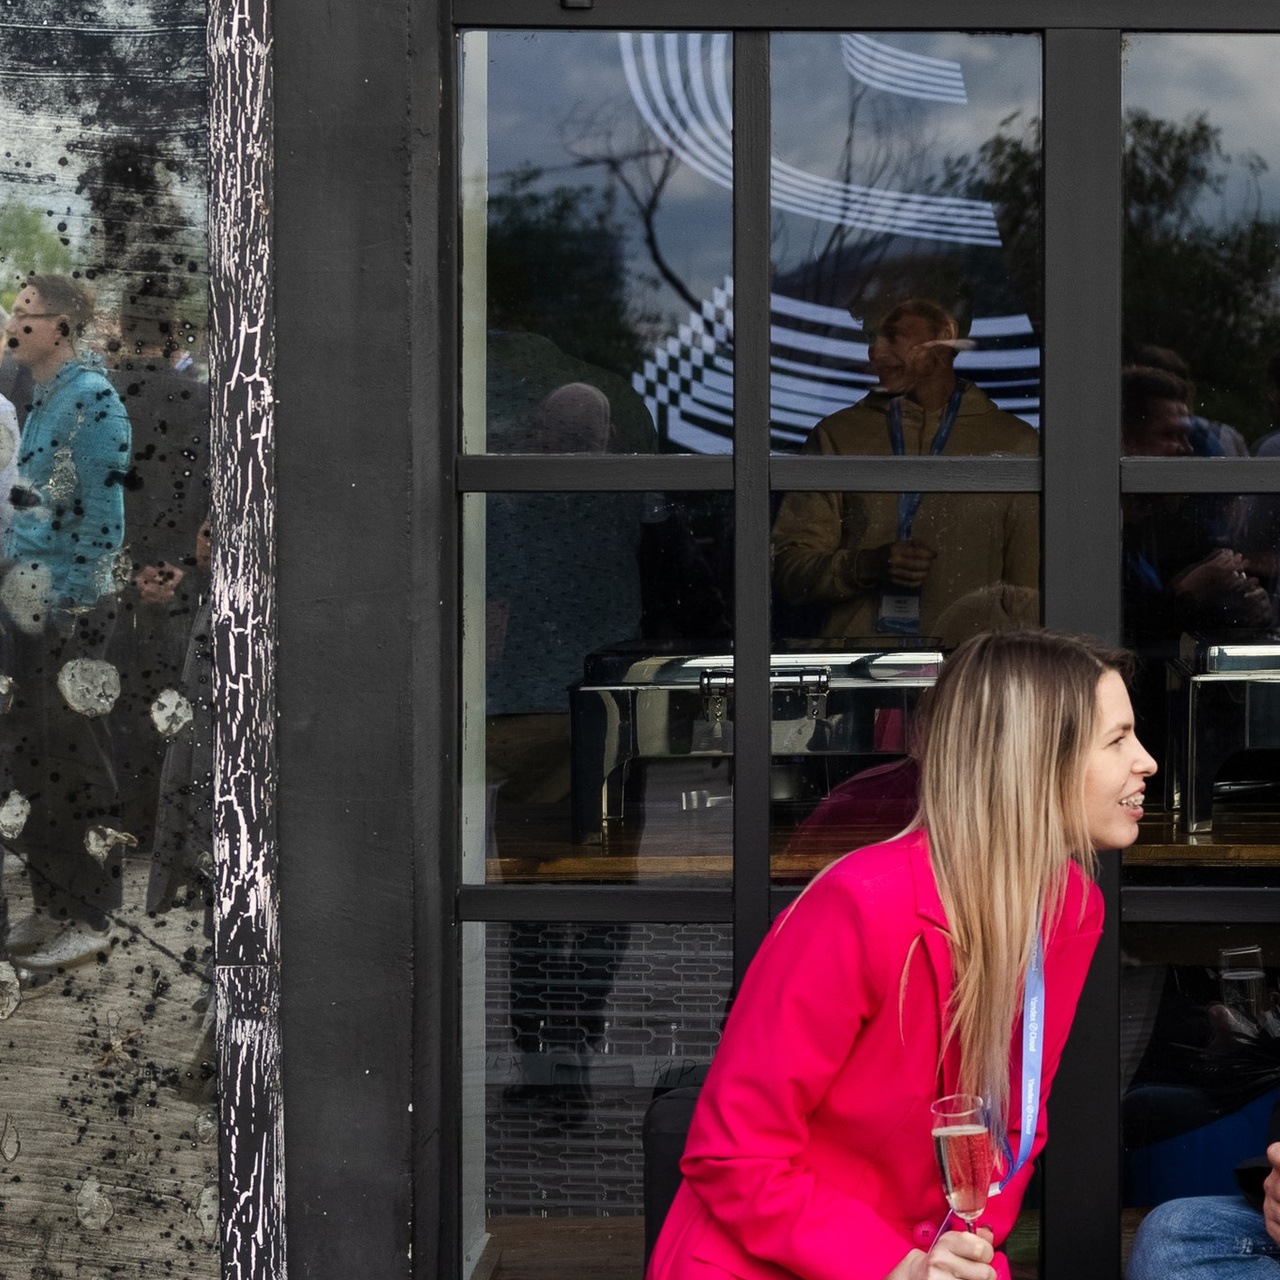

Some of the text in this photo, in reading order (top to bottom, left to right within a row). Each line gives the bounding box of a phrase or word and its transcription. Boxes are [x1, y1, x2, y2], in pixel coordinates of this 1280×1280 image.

[1028, 996, 1038, 1052] Yandex Cloud
[1025, 1078, 1035, 1135] Yandex Cloud
